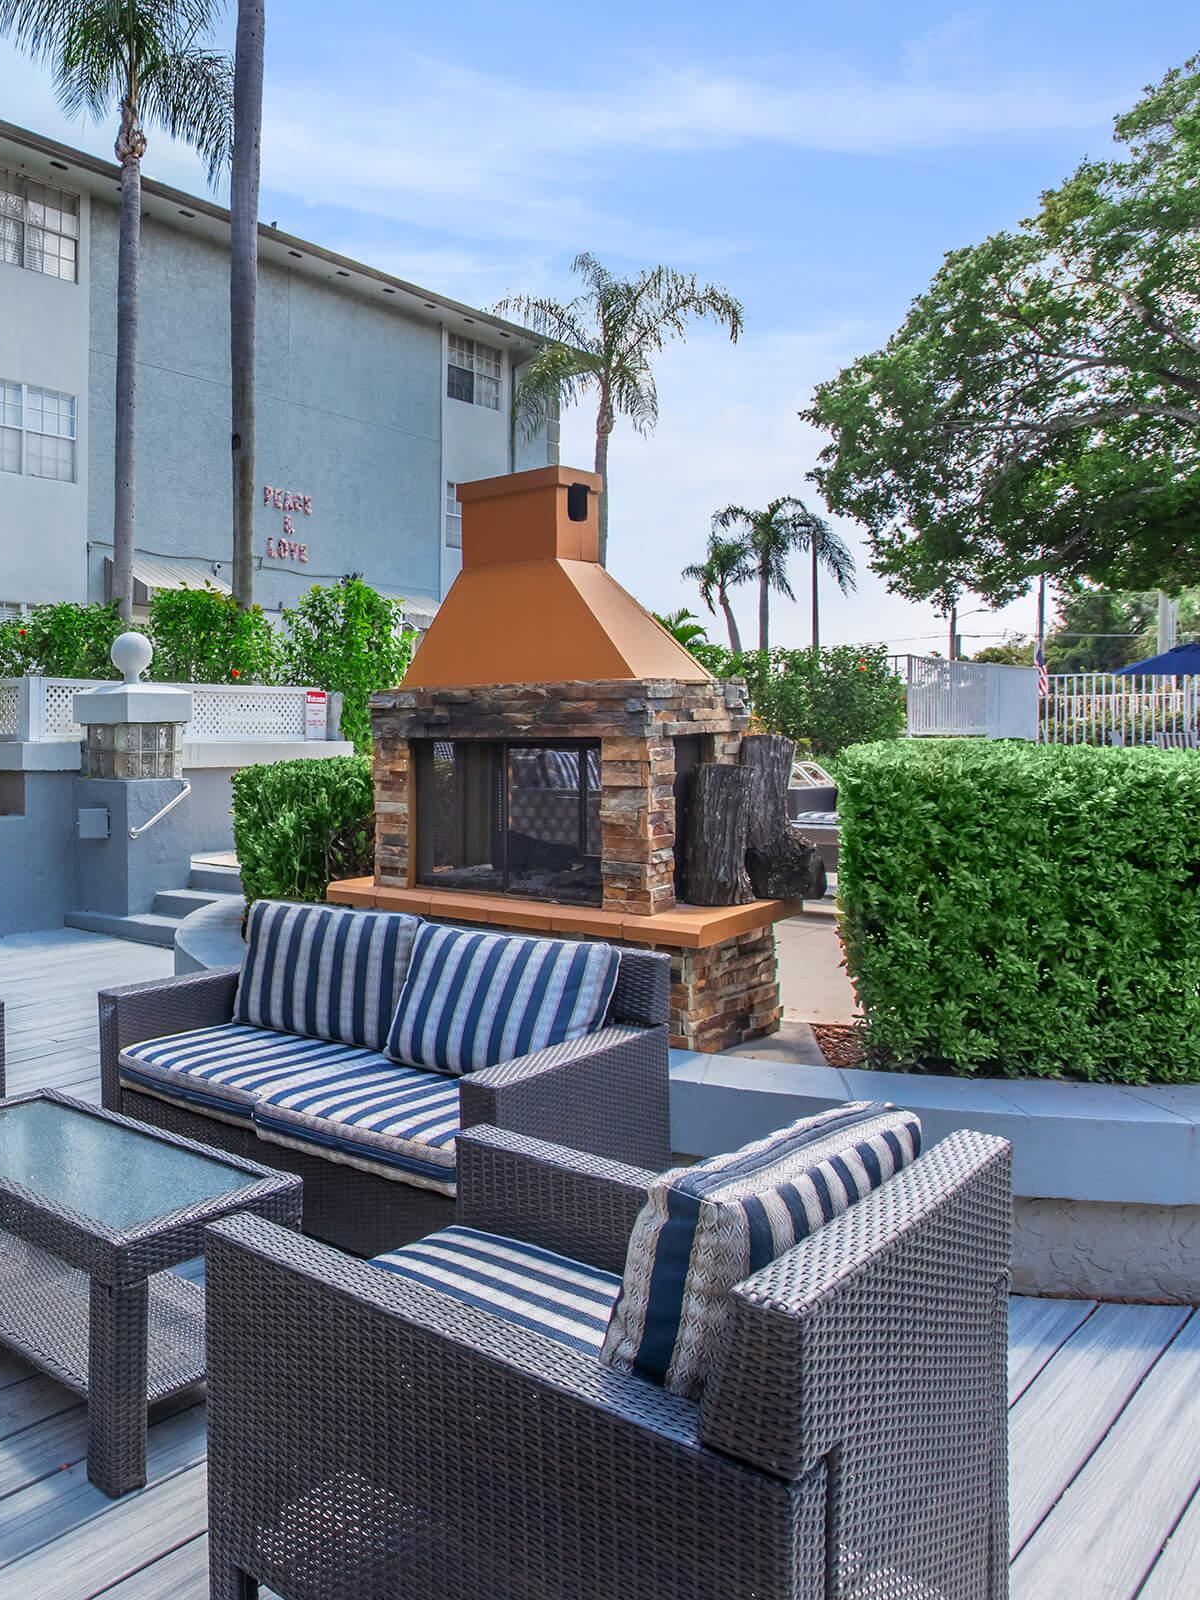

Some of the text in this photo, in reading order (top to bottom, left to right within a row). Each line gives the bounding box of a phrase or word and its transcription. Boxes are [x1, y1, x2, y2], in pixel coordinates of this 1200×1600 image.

[263, 485, 312, 515] PEACE
[283, 514, 295, 535] &
[267, 537, 309, 563] LOVE
